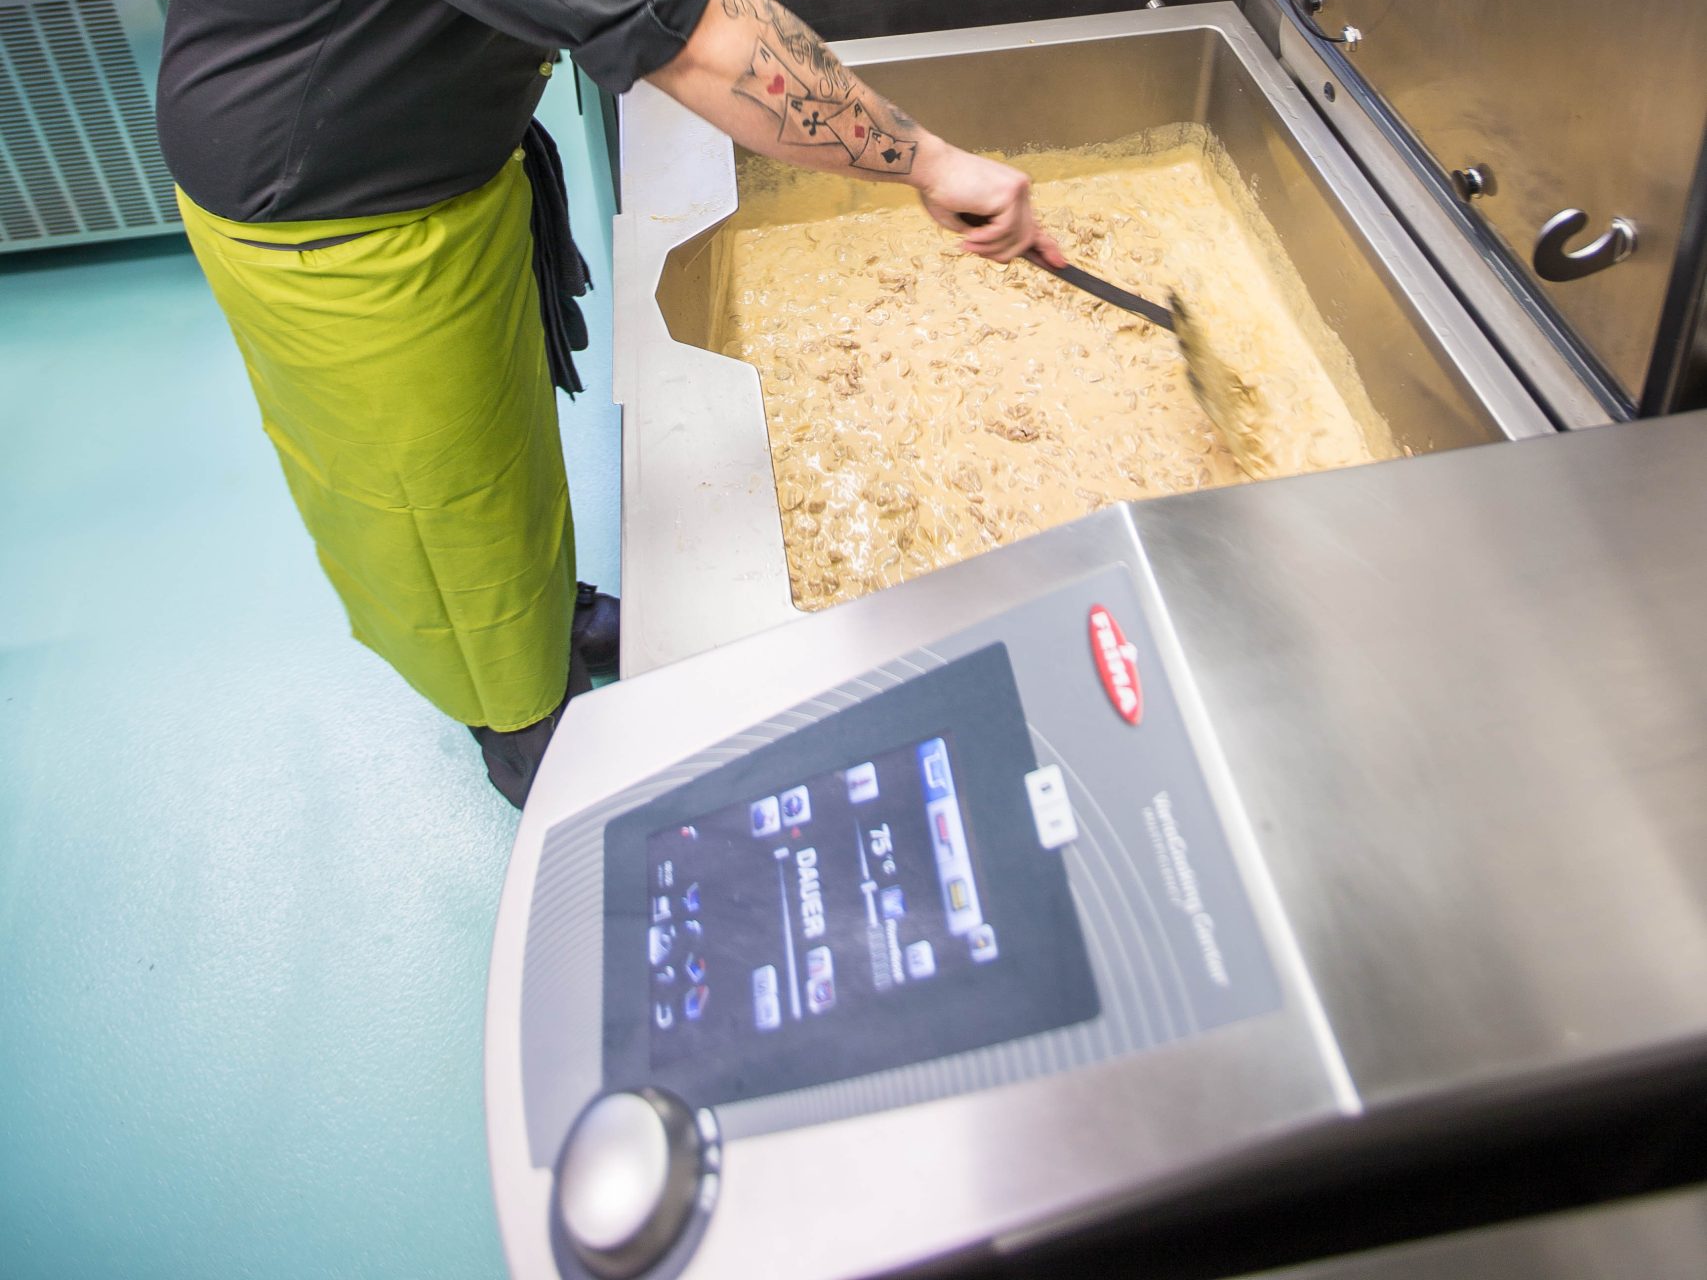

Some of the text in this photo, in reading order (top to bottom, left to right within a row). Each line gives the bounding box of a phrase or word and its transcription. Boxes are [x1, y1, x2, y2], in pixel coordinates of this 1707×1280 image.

[790, 101, 804, 113] A
[871, 133, 882, 144] A
[869, 822, 892, 858] 75
[795, 847, 826, 938] DAUER
